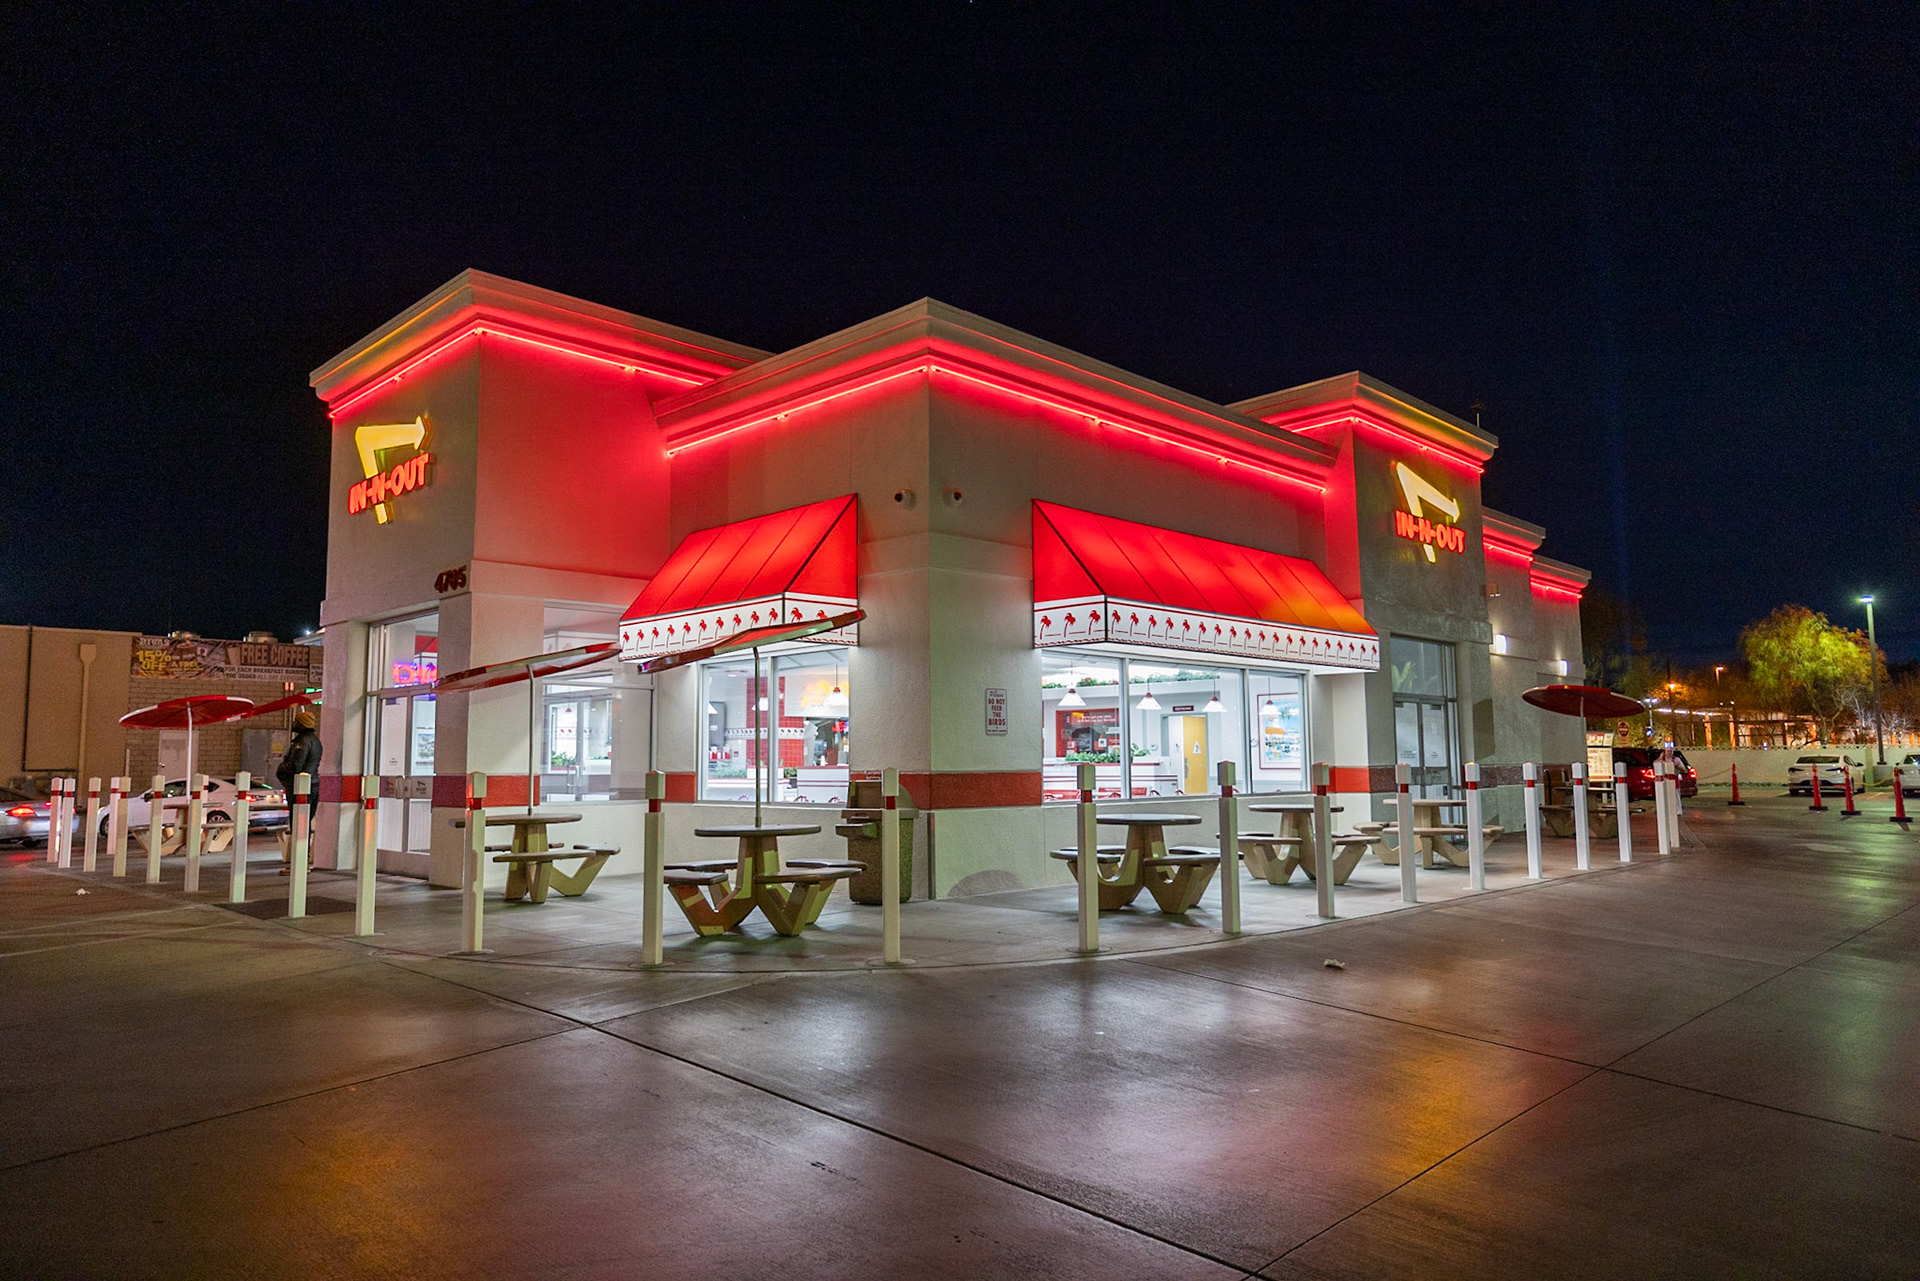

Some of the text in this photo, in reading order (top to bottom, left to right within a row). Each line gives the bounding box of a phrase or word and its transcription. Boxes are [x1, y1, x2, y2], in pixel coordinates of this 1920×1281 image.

[348, 452, 430, 515] IN-N-OUT
[1395, 509, 1466, 554] IN-N-OUT
[136, 649, 172, 662] 15%
[141, 660, 167, 671] OFF
[241, 643, 309, 667] FREE COFFEE
